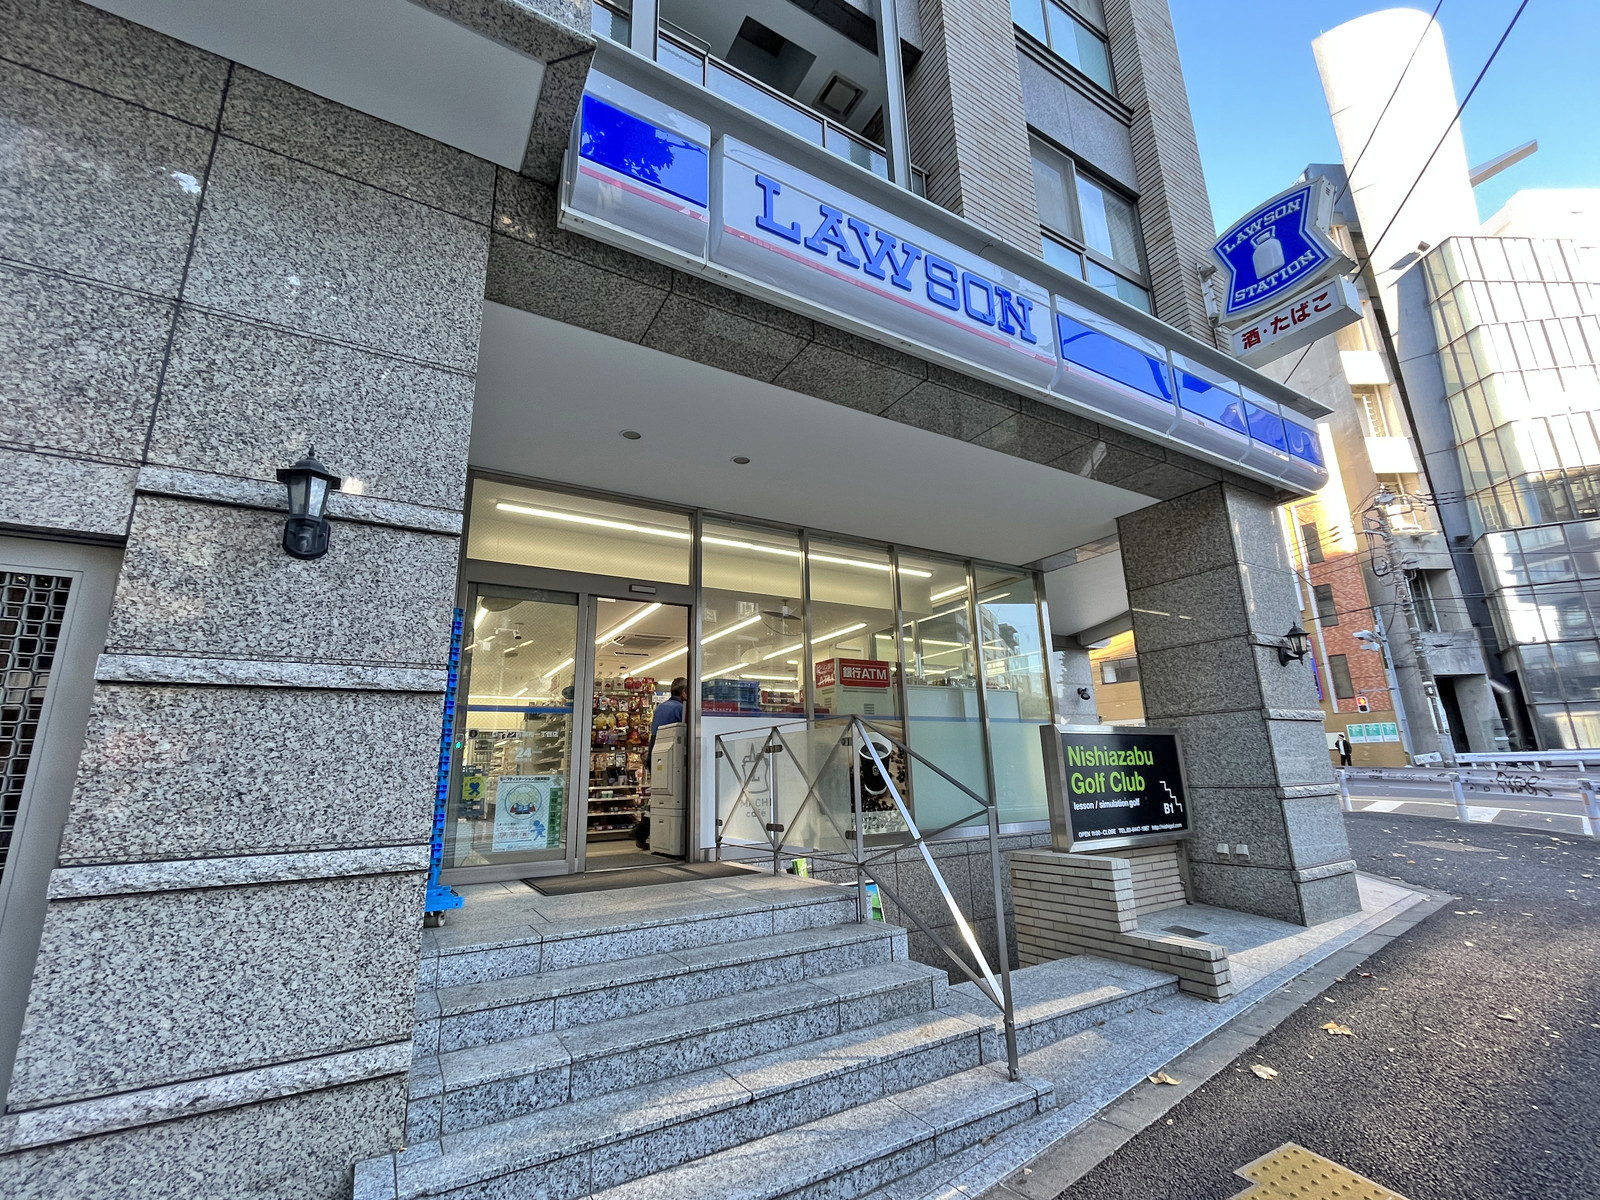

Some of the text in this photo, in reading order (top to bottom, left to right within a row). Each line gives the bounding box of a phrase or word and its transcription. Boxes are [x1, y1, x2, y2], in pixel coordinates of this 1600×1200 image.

[1223, 198, 1301, 255] LAWSON
[755, 174, 1038, 345] LAWSON
[1235, 249, 1316, 302] STATION
[1241, 292, 1332, 350] 酒・たばこ
[842, 666, 887, 680] 銀行ATM
[1067, 745, 1154, 767] Nishiazabu
[1071, 771, 1146, 794] Golf Club
[1073, 801, 1095, 811] lesson
[1099, 799, 1129, 809] simulation
[1129, 797, 1140, 809] golf
[1163, 802, 1175, 814] B1
[1078, 830, 1091, 838] OPEN
